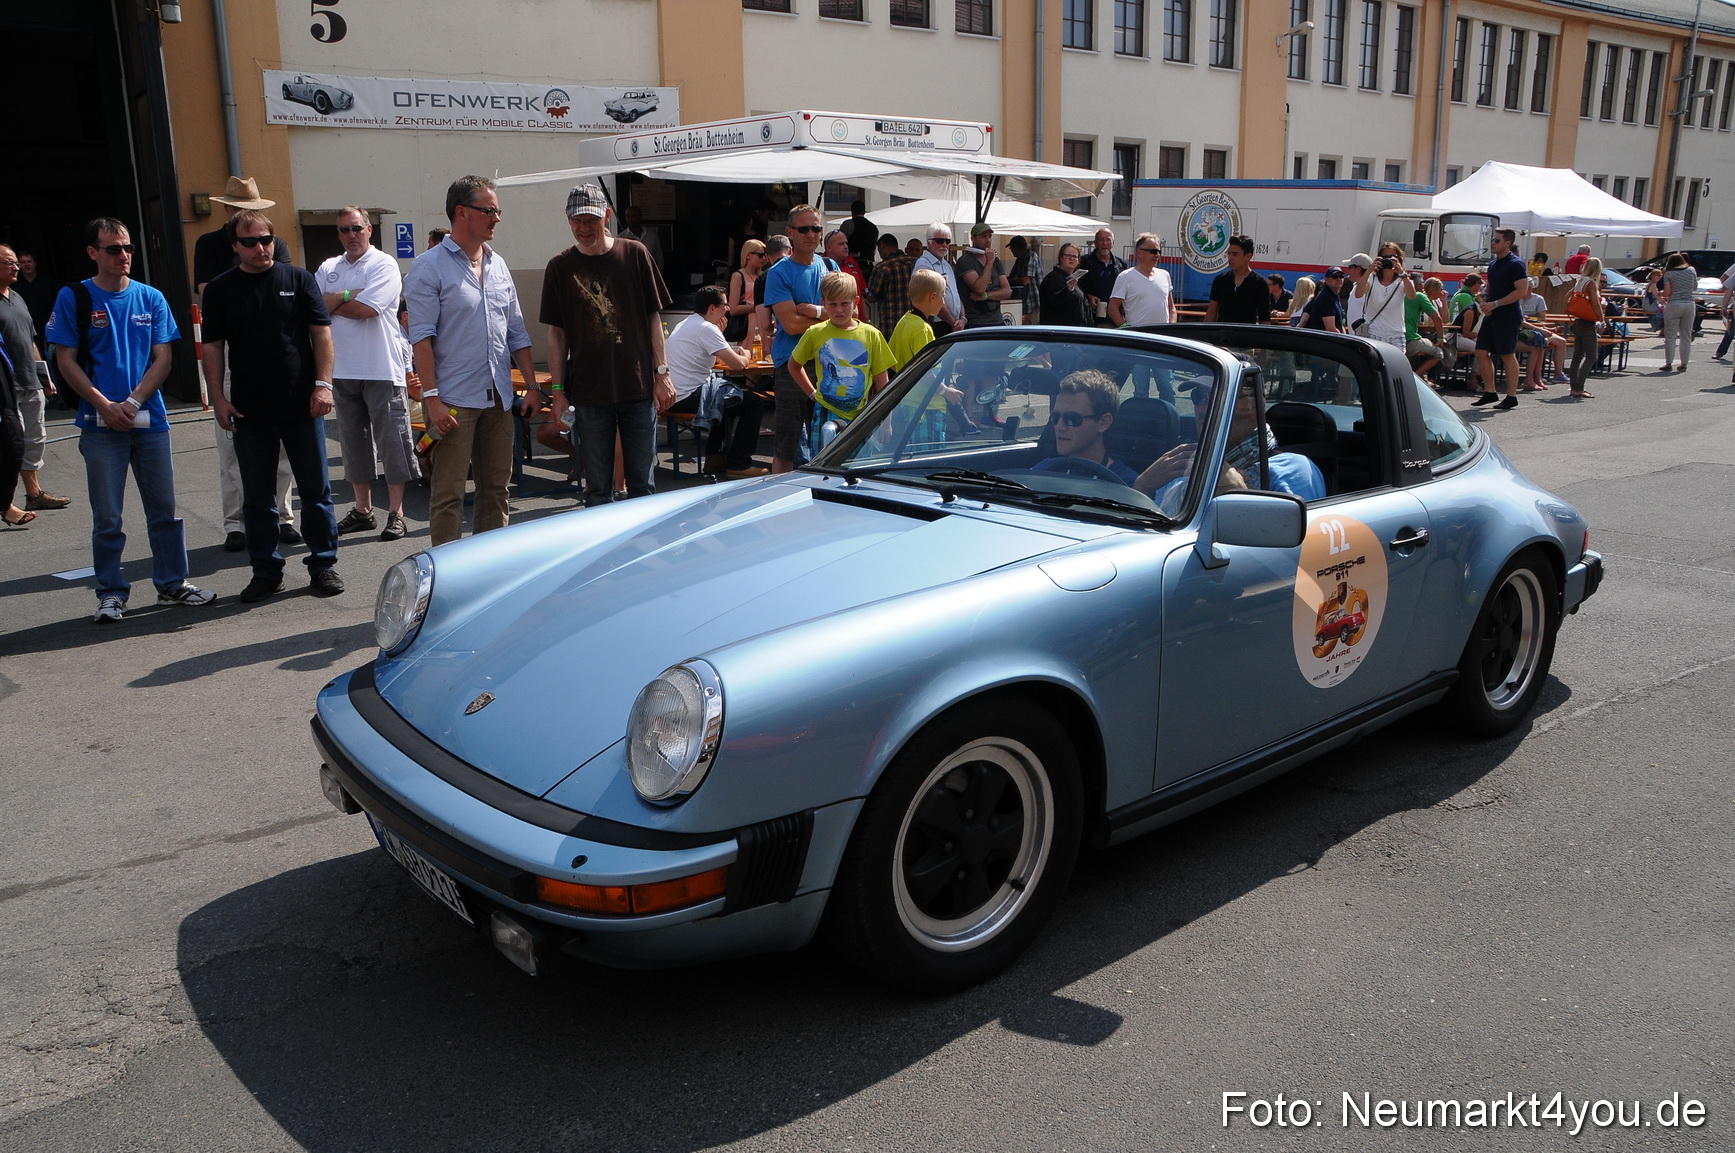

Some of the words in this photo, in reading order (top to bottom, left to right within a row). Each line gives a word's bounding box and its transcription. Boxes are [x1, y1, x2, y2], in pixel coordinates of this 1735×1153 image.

[310, 0, 348, 44] 5
[393, 91, 541, 112] OFENWERK
[272, 113, 328, 123] www.ofenwerk.de
[333, 115, 388, 125] www.ofenwerk.de
[578, 122, 625, 130] www.ofenwerk.de
[688, 131, 703, 150] Bräu
[706, 127, 745, 148] Buttenheim
[872, 135, 893, 148] Georgen
[892, 136, 906, 148] Bräu
[907, 137, 935, 149] Buttenheim
[1702, 177, 1711, 198] 5
[1196, 193, 1219, 205] Georgen
[396, 224, 408, 240] P
[1255, 243, 1269, 255] 1624
[1192, 254, 1224, 269] Buttenheim
[1319, 519, 1351, 556] 22
[1316, 555, 1366, 579] PORSCHE
[1335, 569, 1349, 581] 911
[1325, 647, 1352, 663] JAHRE
